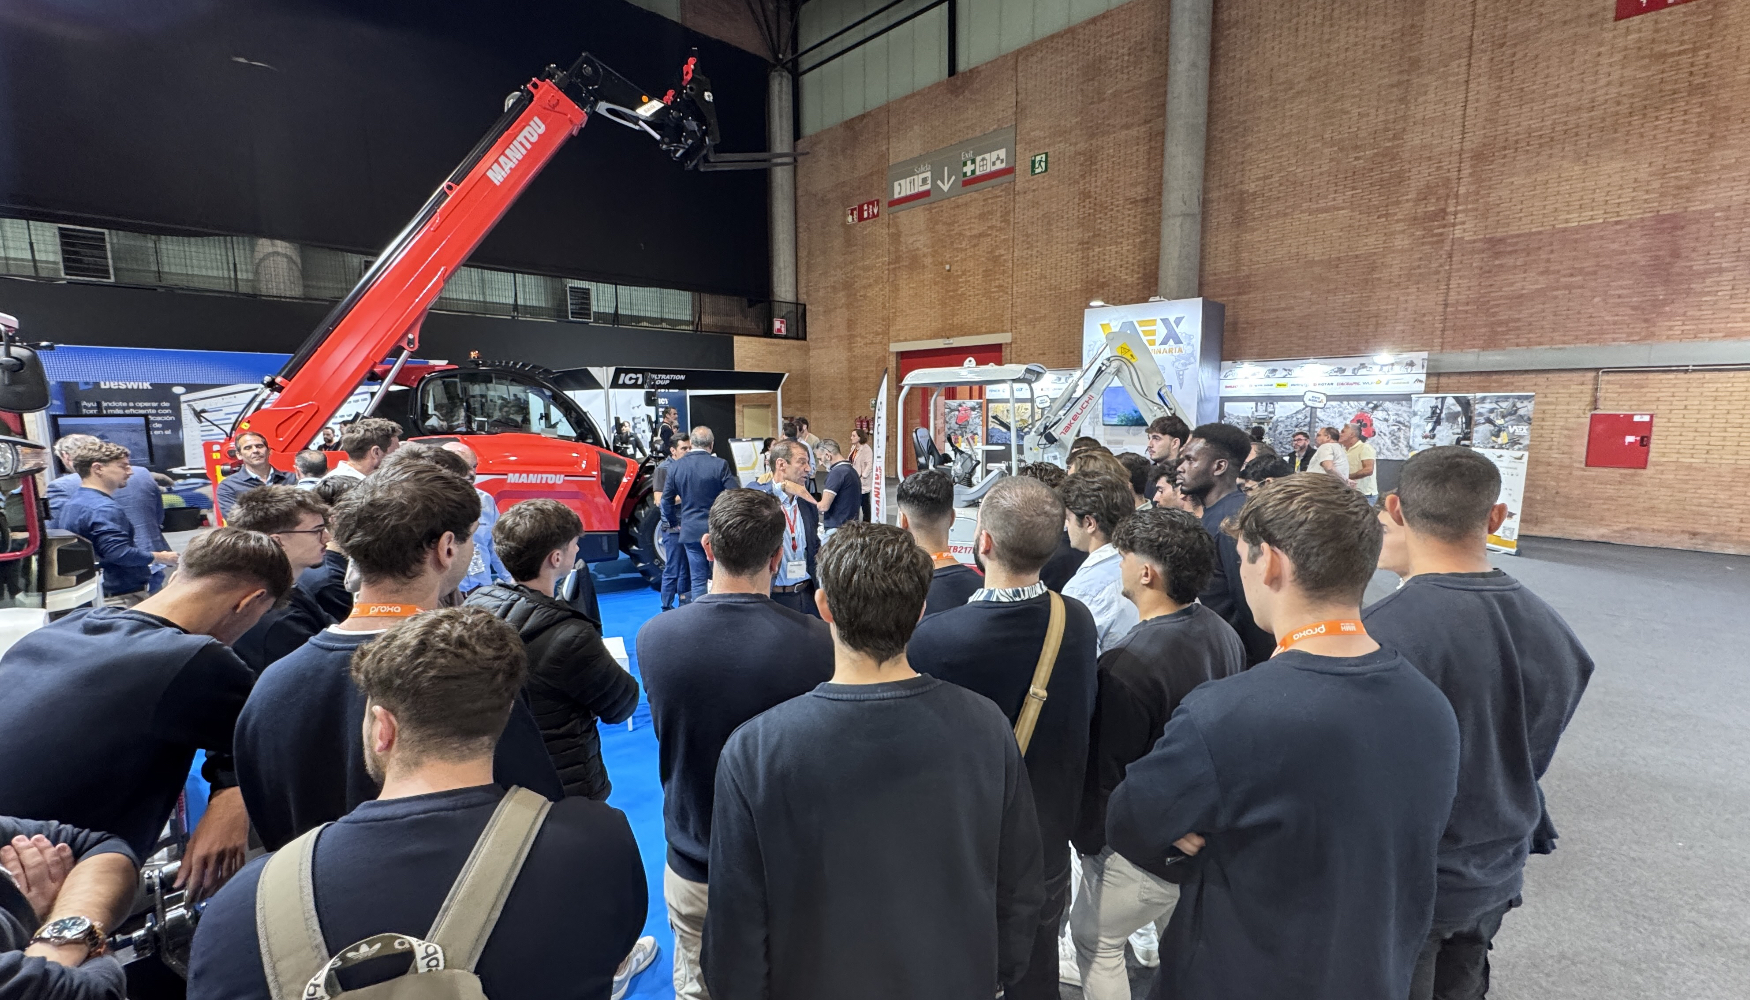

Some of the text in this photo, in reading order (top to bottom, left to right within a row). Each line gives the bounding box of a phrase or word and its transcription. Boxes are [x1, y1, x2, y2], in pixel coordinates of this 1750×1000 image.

[486, 116, 546, 187] MANITOU
[961, 151, 974, 160] Exit
[914, 163, 931, 174] Salida
[506, 473, 565, 484] MANITOU
[948, 545, 975, 554] TB217
[370, 606, 401, 614] proxa
[1293, 624, 1326, 640] proxa
